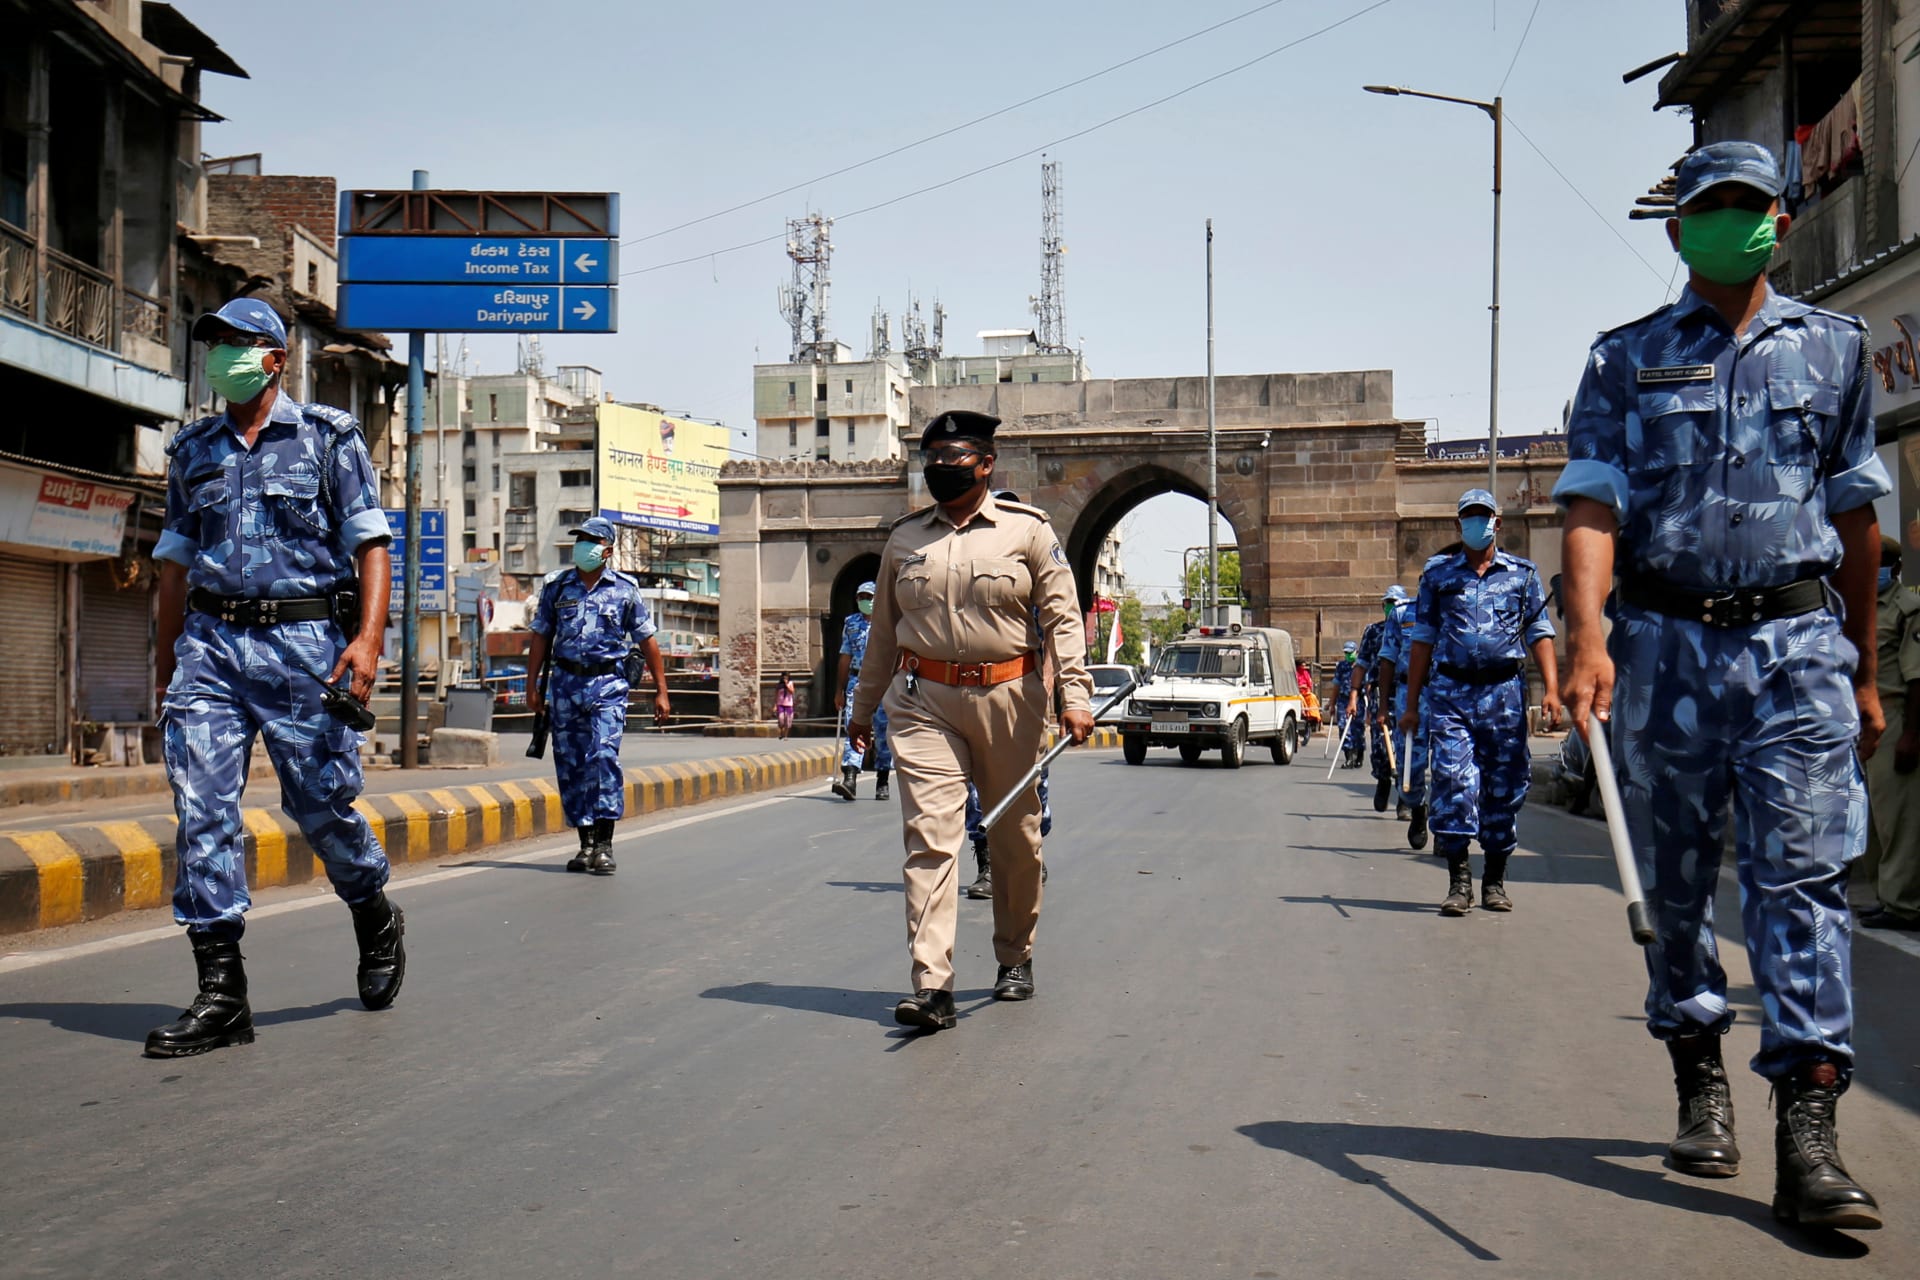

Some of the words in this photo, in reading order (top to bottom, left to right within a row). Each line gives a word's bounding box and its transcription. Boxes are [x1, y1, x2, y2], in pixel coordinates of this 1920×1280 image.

[465, 262, 519, 274] Income
[523, 262, 549, 274] Tax
[494, 290, 549, 309] દરિયાપુર
[477, 310, 549, 325] Dariyapur
[608, 441, 643, 469] नेशनल
